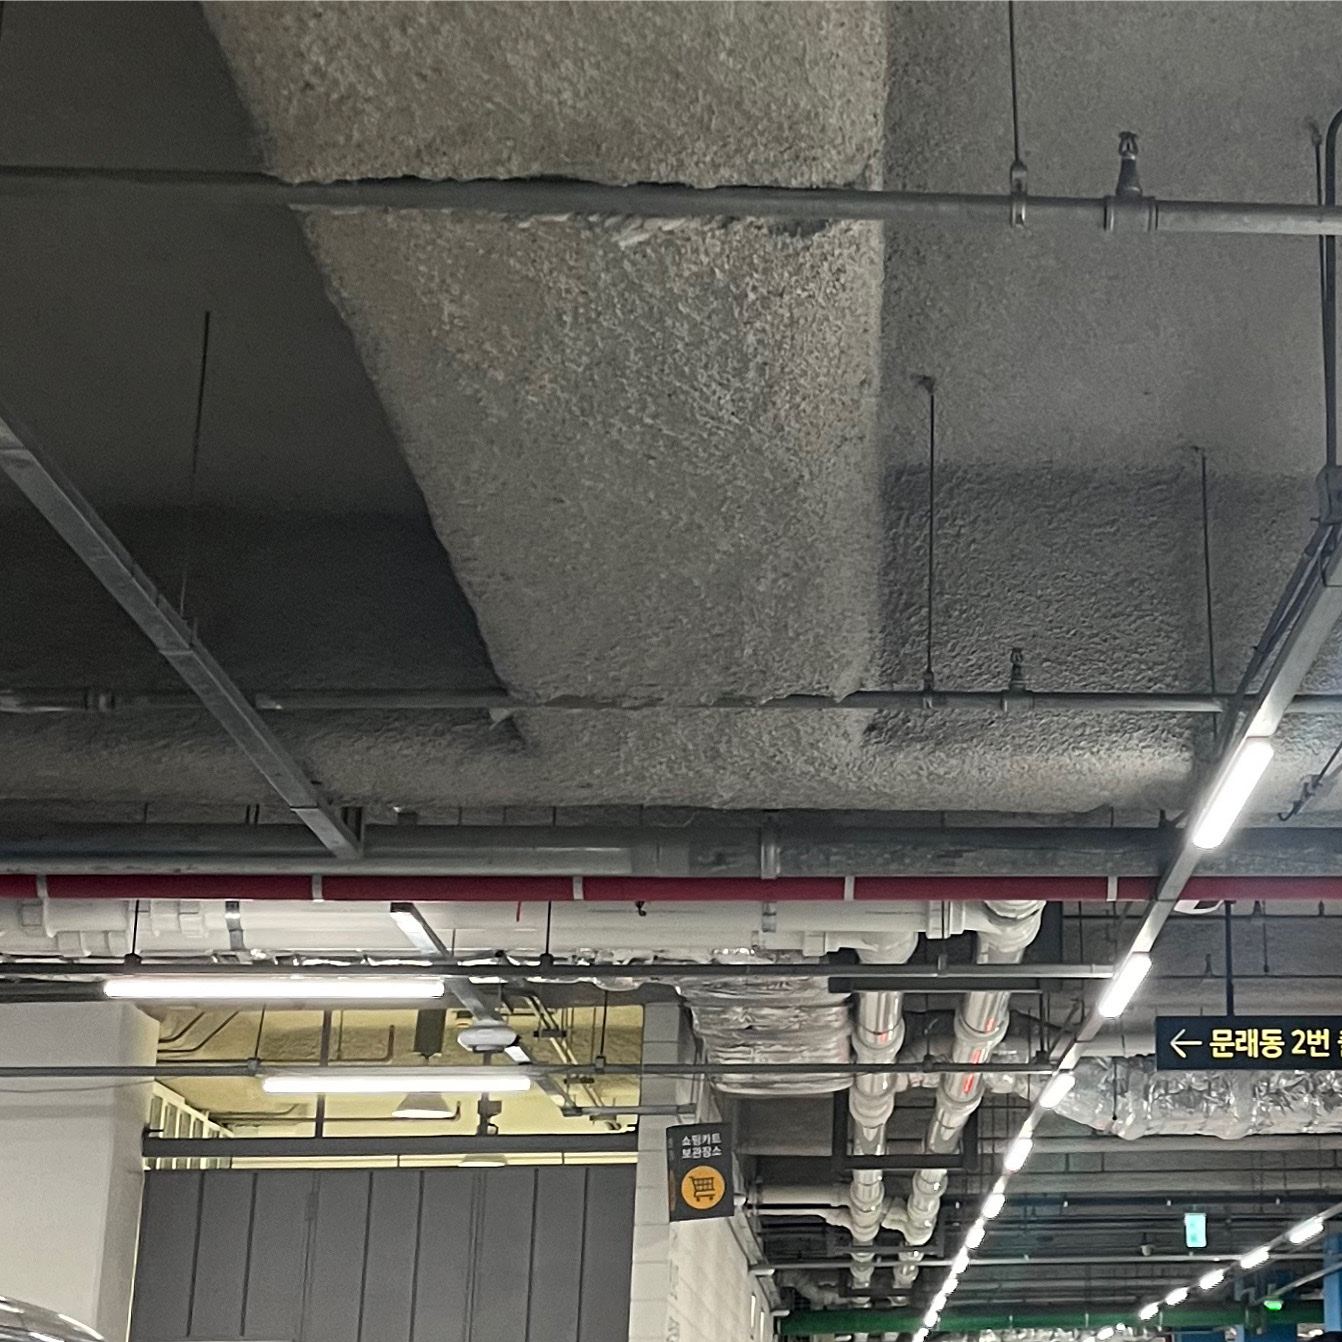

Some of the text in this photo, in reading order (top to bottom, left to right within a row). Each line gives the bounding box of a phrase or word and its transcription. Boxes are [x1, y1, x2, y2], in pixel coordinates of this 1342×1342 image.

[1209, 1028, 1285, 1058] 문래동
[1291, 1029, 1330, 1057] 2번
[681, 1133, 721, 1146] 쇼핑카트
[681, 1146, 722, 1159] 보관장소
